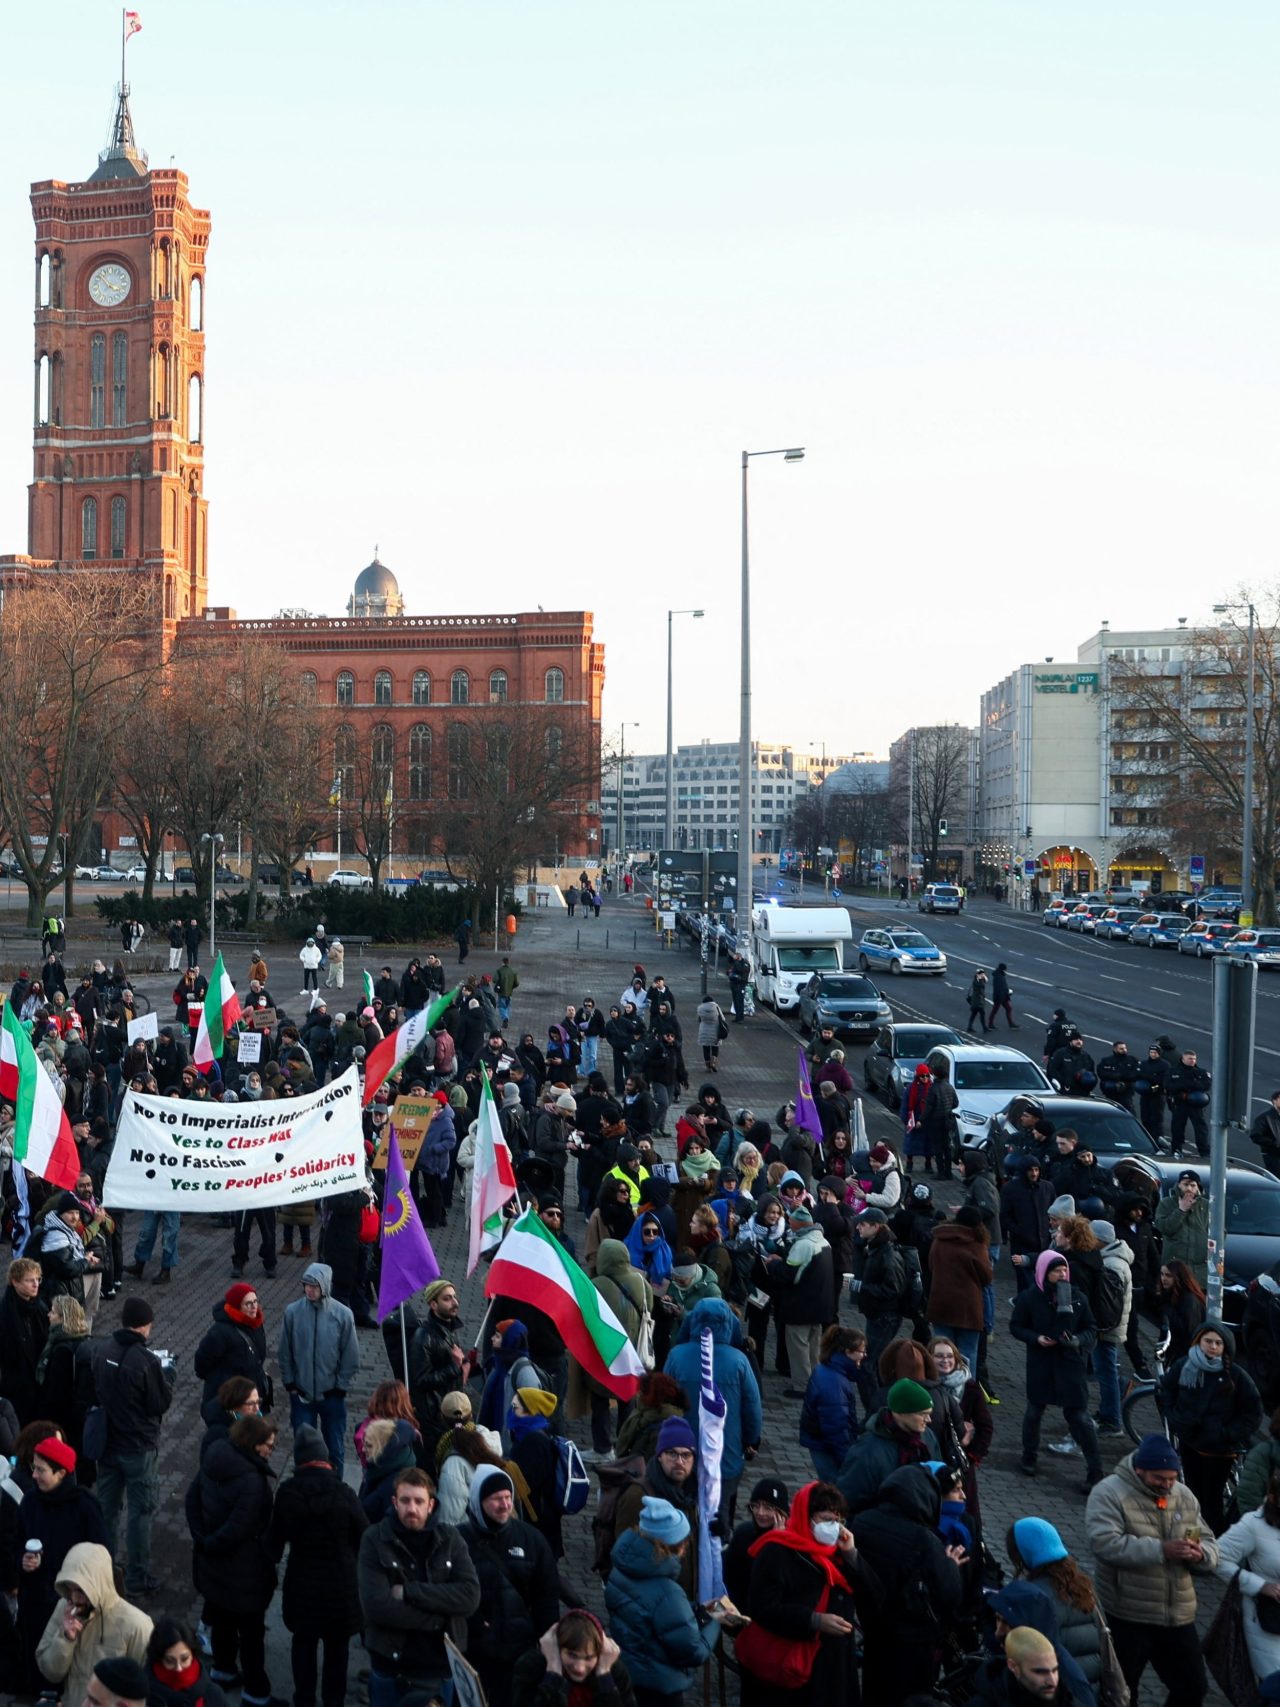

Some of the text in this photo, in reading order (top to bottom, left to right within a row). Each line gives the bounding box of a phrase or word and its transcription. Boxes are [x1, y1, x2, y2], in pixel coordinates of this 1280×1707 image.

[134, 1101, 154, 1119] No
[159, 1111, 177, 1125] to
[181, 1113, 274, 1131] Imperialist
[397, 1104, 430, 1117] FREEDOM
[403, 1118, 416, 1129] IS
[172, 1129, 292, 1149] Yes to Class War
[394, 1128, 423, 1139] EMINIST
[130, 1149, 247, 1168] No to Fascism
[171, 1153, 356, 1191] Yes to Peoples' Solidarity
